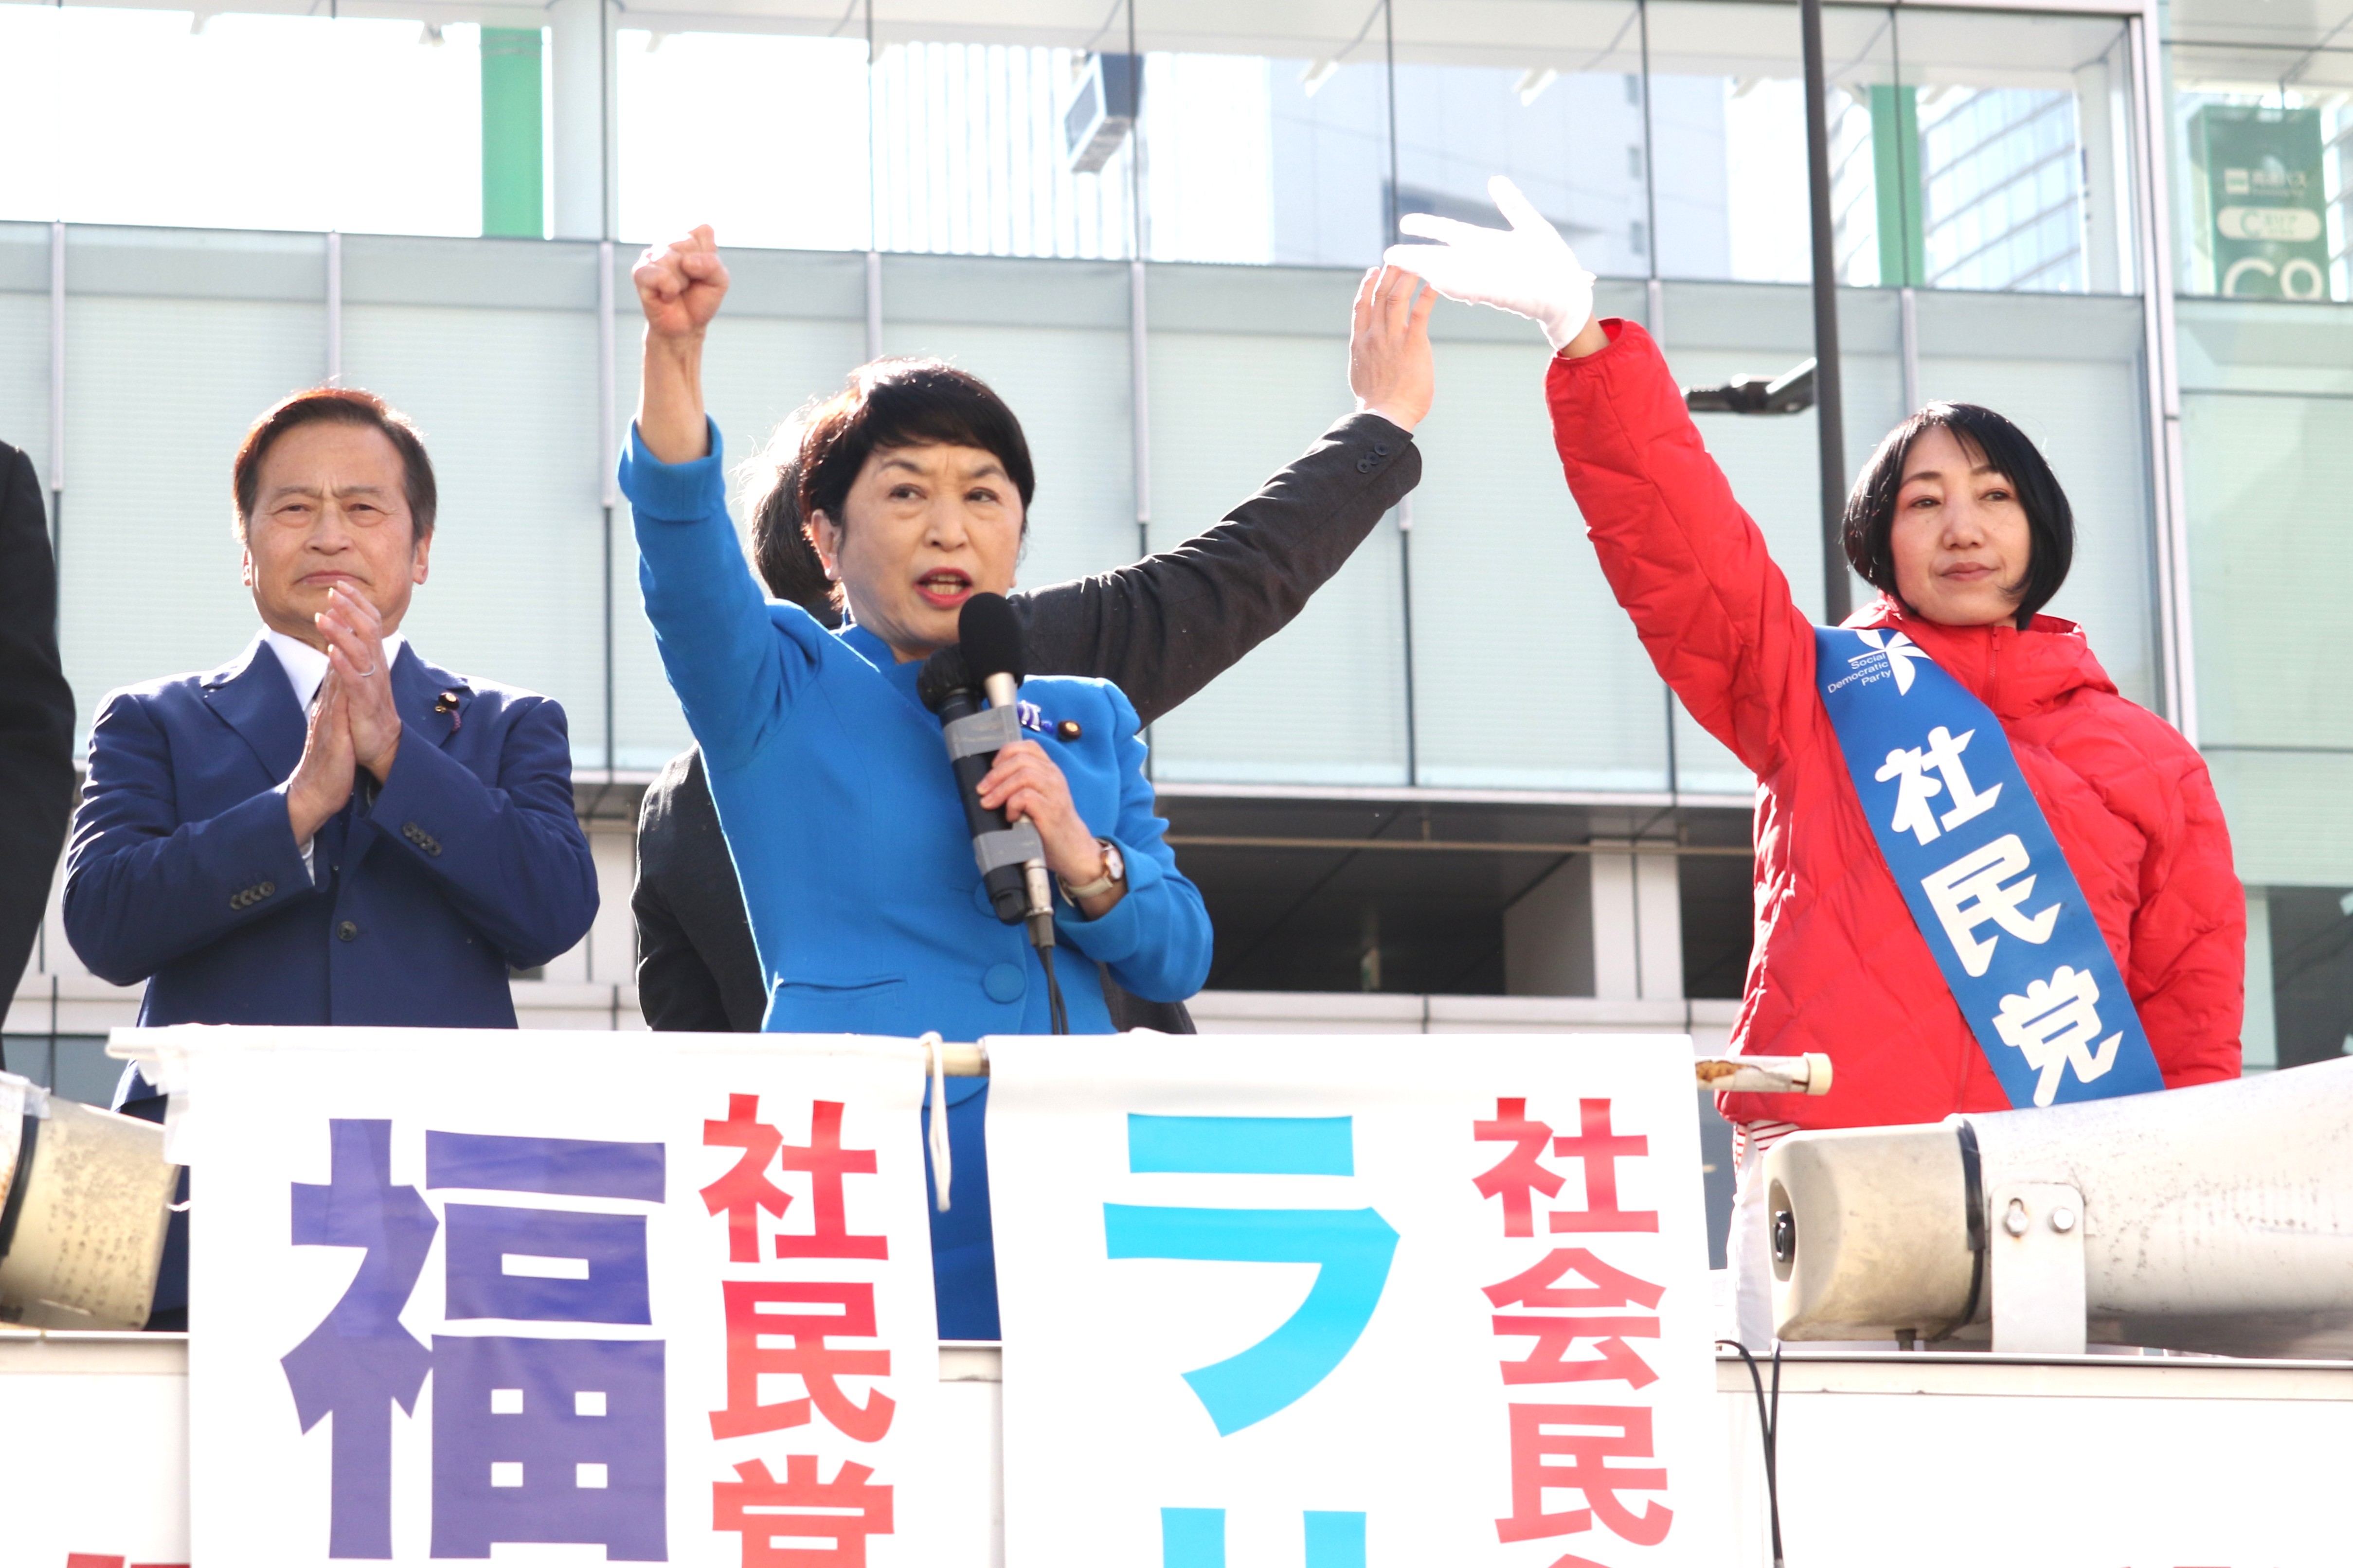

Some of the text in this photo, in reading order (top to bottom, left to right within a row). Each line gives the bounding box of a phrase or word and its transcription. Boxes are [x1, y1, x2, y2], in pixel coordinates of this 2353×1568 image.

[1827, 661, 1889, 694] Democratic
[1850, 653, 1886, 670] Social
[1862, 670, 1891, 686] Party
[1874, 726, 2123, 1108] 社民党
[280, 1118, 668, 1562] 福
[699, 1093, 896, 1568] 社民党
[1102, 1113, 1401, 1568] ラ
[1472, 1097, 1673, 1568] 社会民
